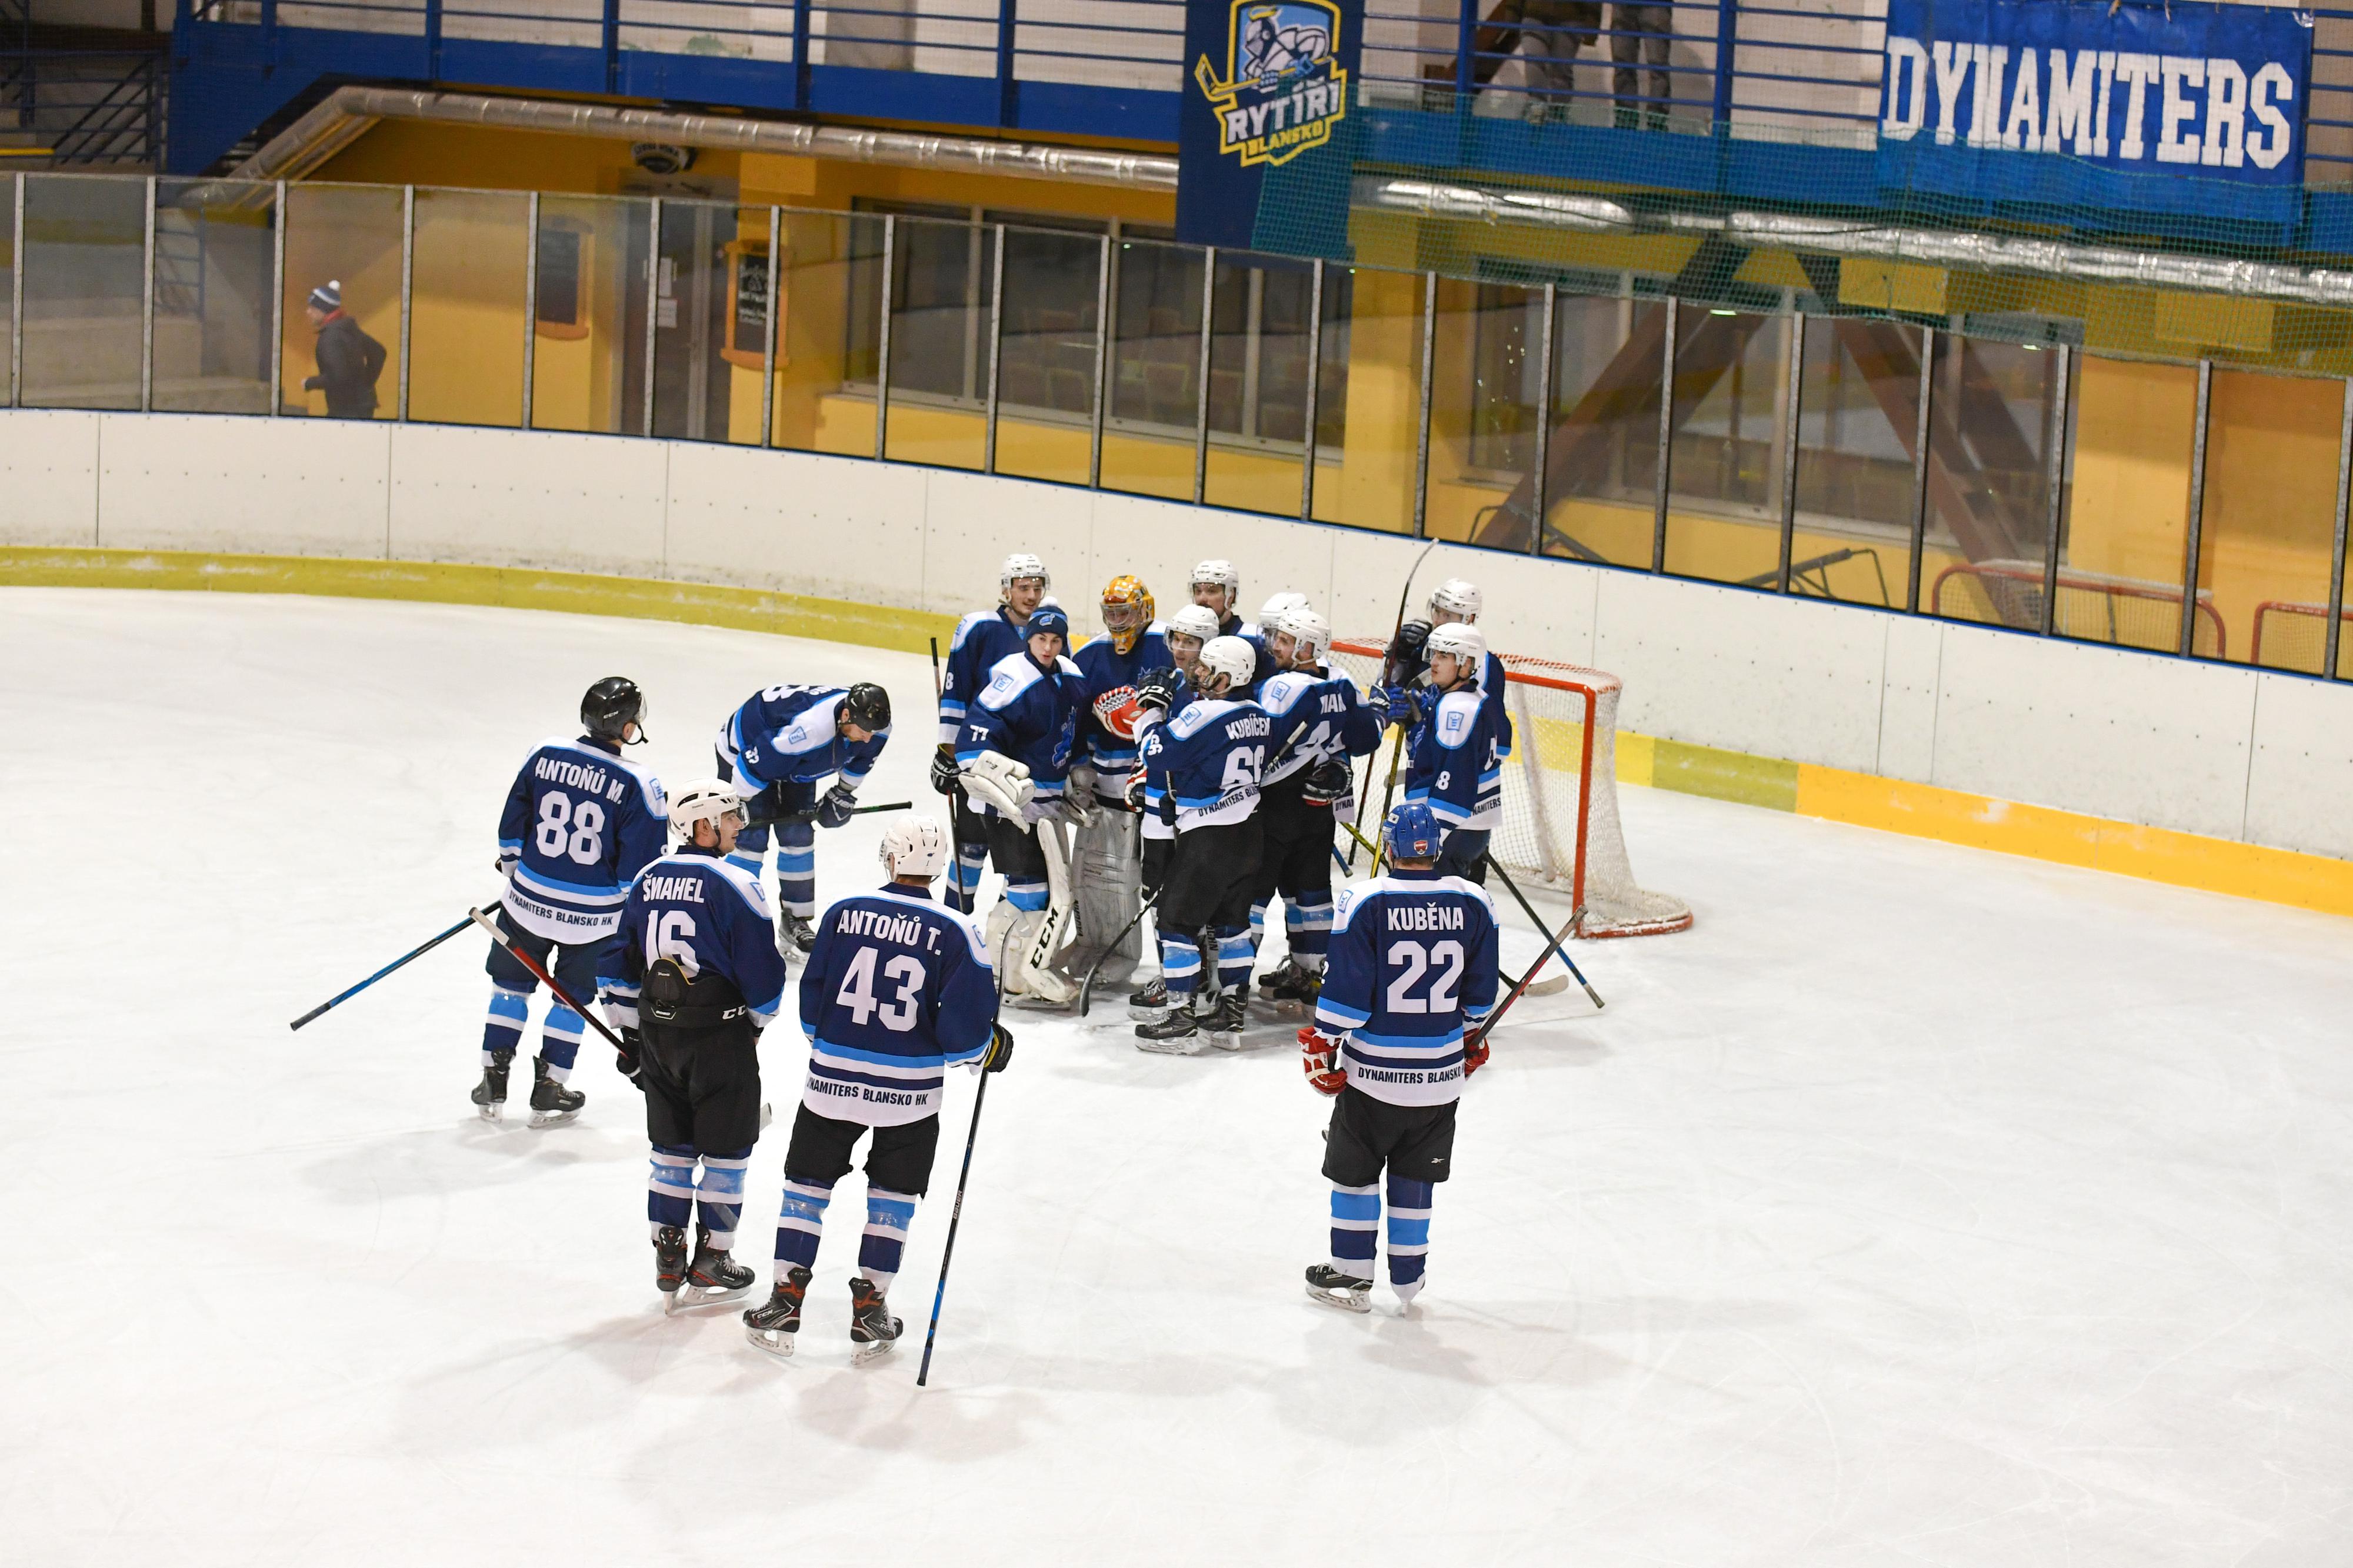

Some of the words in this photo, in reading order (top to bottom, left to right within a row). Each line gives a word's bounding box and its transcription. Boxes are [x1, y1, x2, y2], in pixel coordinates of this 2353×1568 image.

[1882, 36, 2293, 169] DYNAMITERS
[1247, 119, 1324, 155] BLANSKO
[969, 725, 989, 742] 77
[535, 757, 606, 793] ANTOŇŮ
[606, 782, 625, 805] M.
[1198, 792, 1244, 817] DYNAMITERS
[536, 790, 605, 865] 88
[509, 890, 552, 919] DYNAMITERS
[556, 912, 599, 926] BLANSKO
[601, 916, 613, 925] HK
[1387, 902, 1464, 931] KUBĚNA
[646, 910, 701, 979] 16
[837, 909, 922, 946] ANTOŇŮ
[926, 928, 942, 956] T.
[1031, 905, 1058, 969] CCM
[836, 946, 926, 1032] 43
[1387, 940, 1465, 1013] 22
[722, 1005, 746, 1020] CC
[806, 1077, 859, 1097] NAMITERS
[863, 1089, 912, 1106] BLANSKO
[915, 1095, 928, 1106] HK
[1358, 1067, 1423, 1083] DYNAMITERS
[1427, 1066, 1461, 1083] BLANSKO
[756, 1309, 773, 1319] CCM
